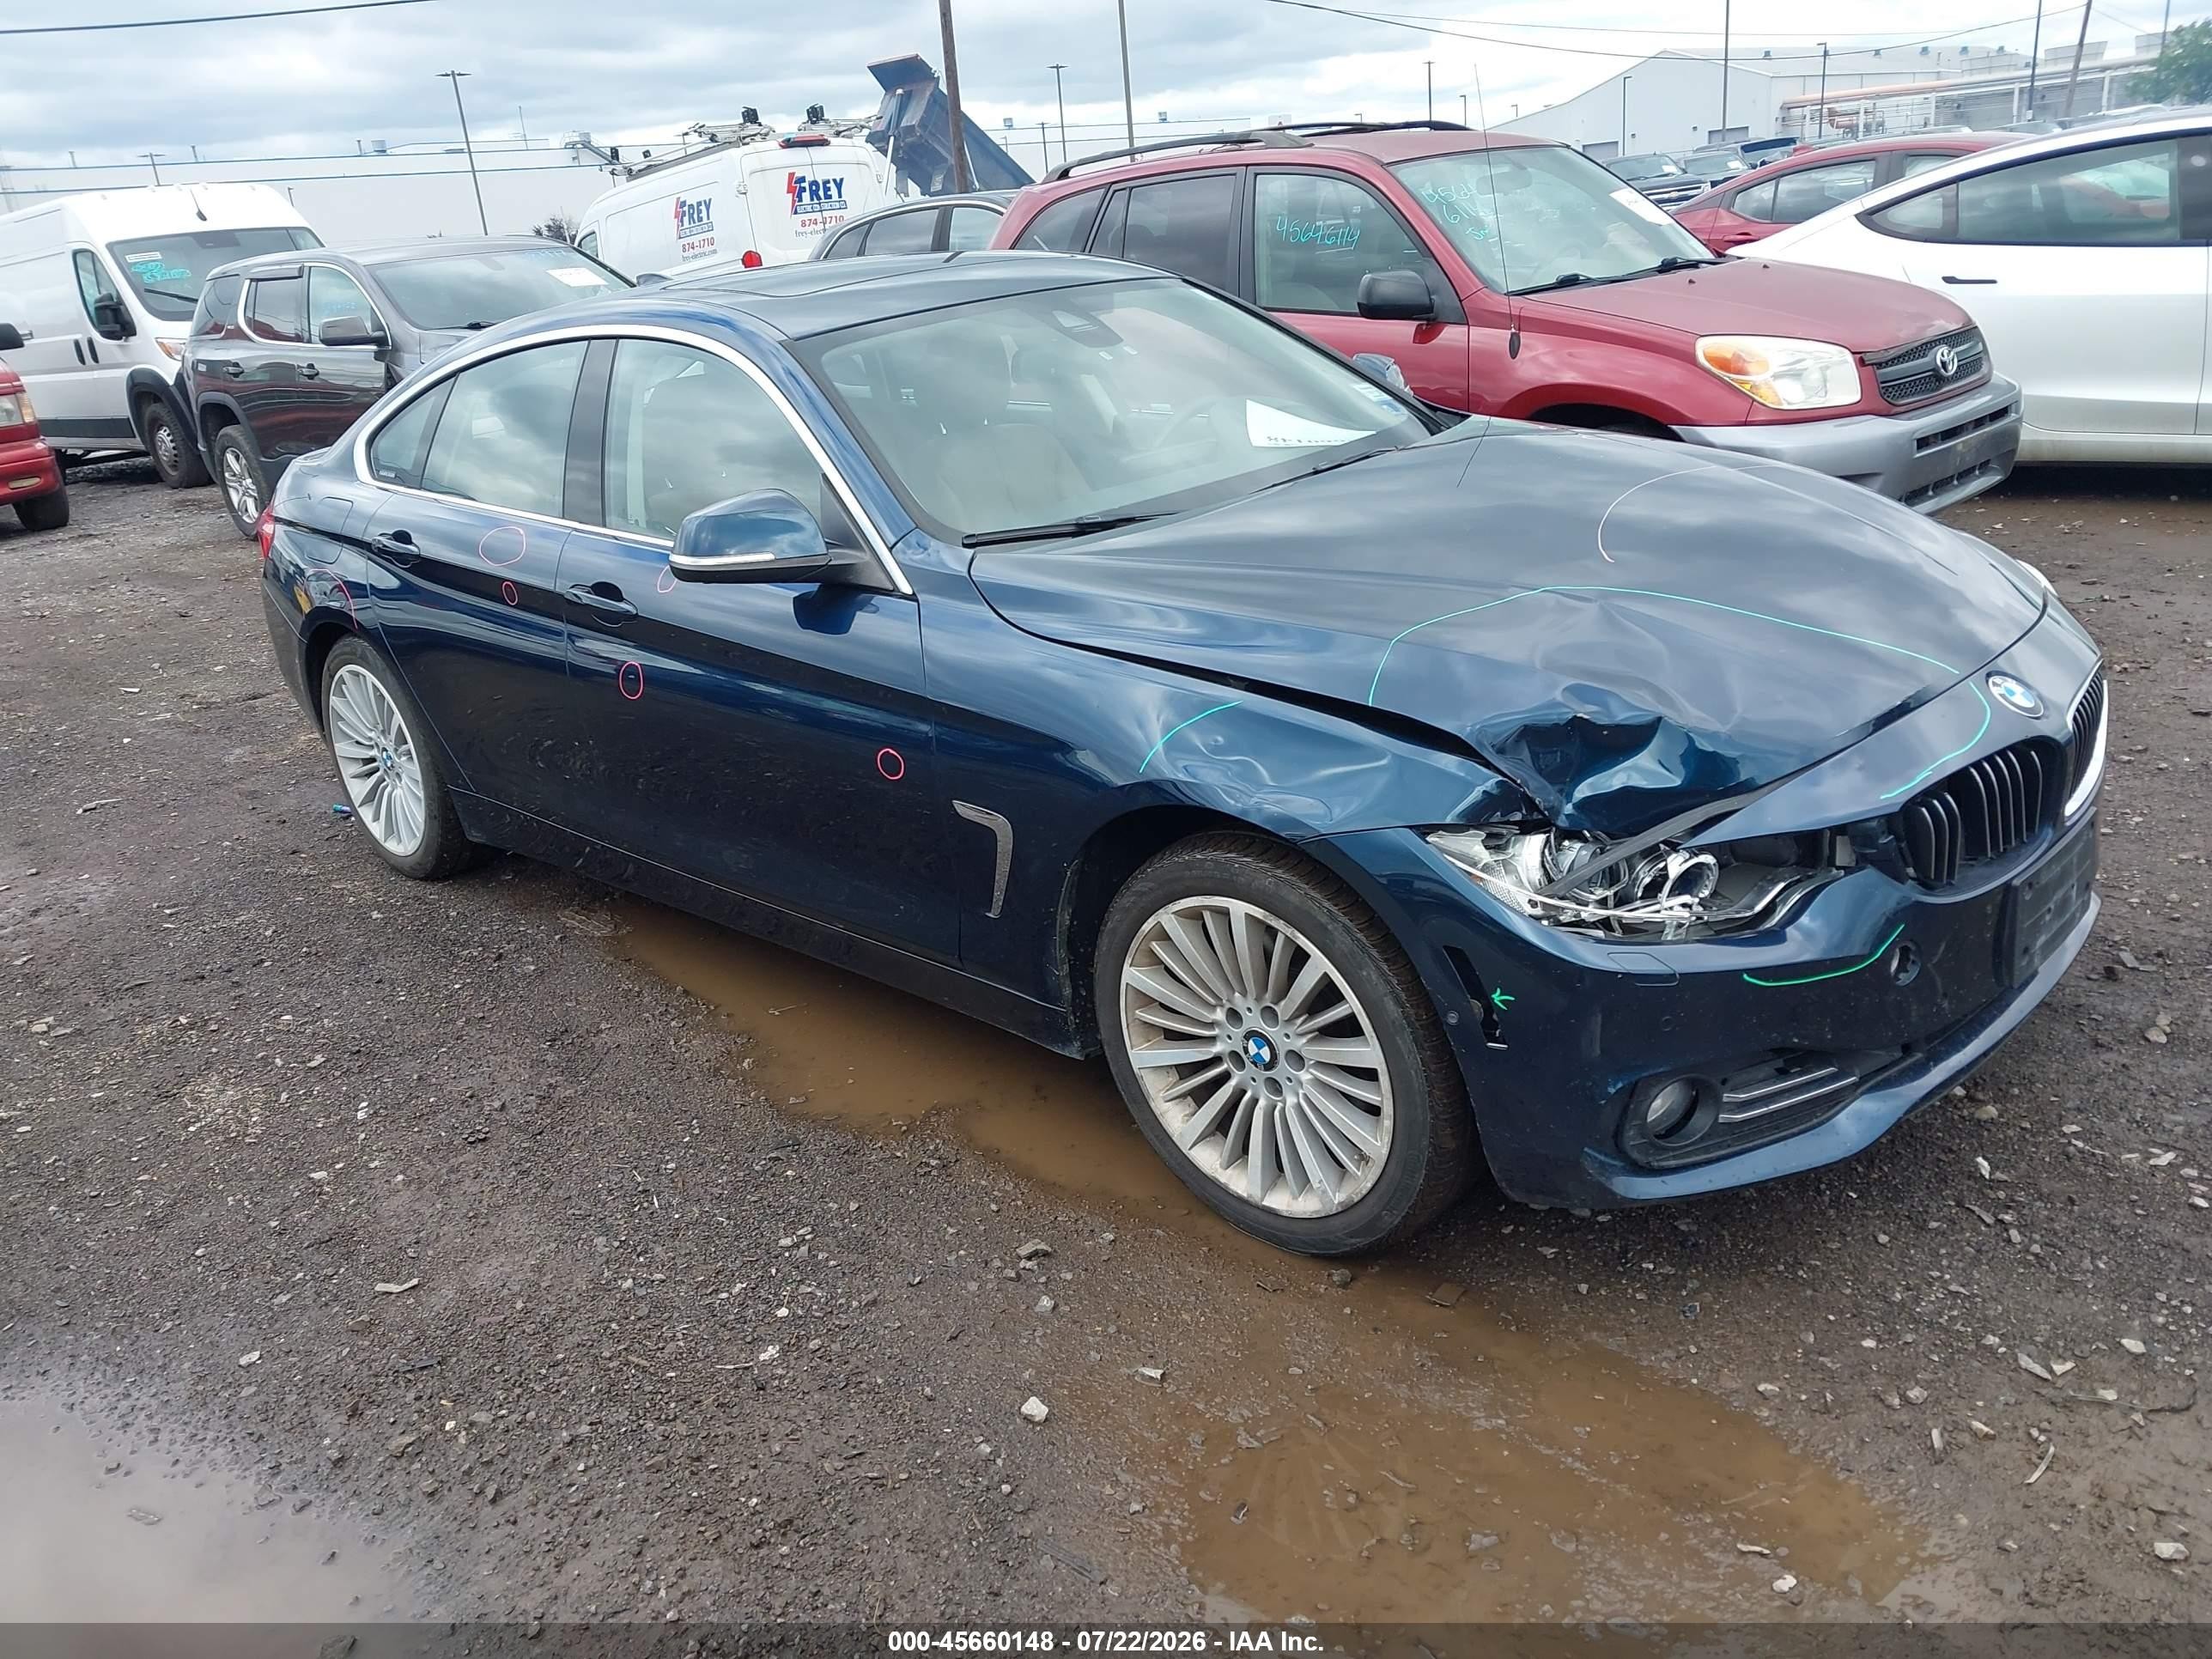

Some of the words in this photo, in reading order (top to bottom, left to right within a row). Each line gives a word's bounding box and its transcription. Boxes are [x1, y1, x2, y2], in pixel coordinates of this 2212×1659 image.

[794, 175, 844, 203] FREY
[678, 198, 712, 228] FREY
[800, 215, 844, 228] 874-1710
[682, 236, 715, 253] 874-1710
[1276, 216, 1360, 251] 45646114
